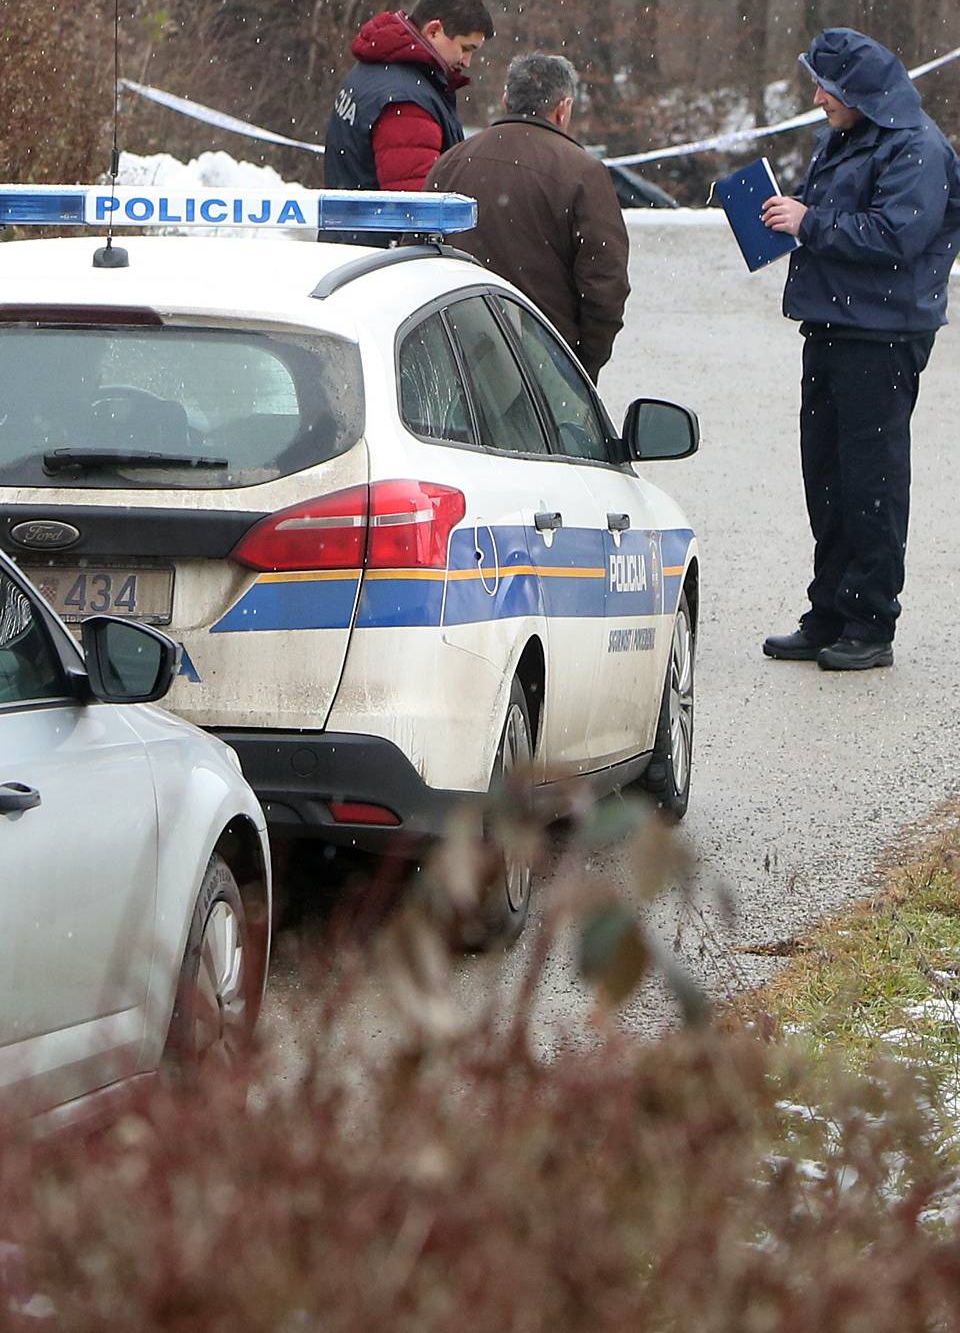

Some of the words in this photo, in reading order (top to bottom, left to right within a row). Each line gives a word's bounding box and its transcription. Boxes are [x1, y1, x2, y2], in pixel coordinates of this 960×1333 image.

[95, 196, 307, 225] POLICIJA
[25, 525, 64, 542] Ford
[609, 554, 647, 593] POLICIJA
[64, 574, 137, 612] 434
